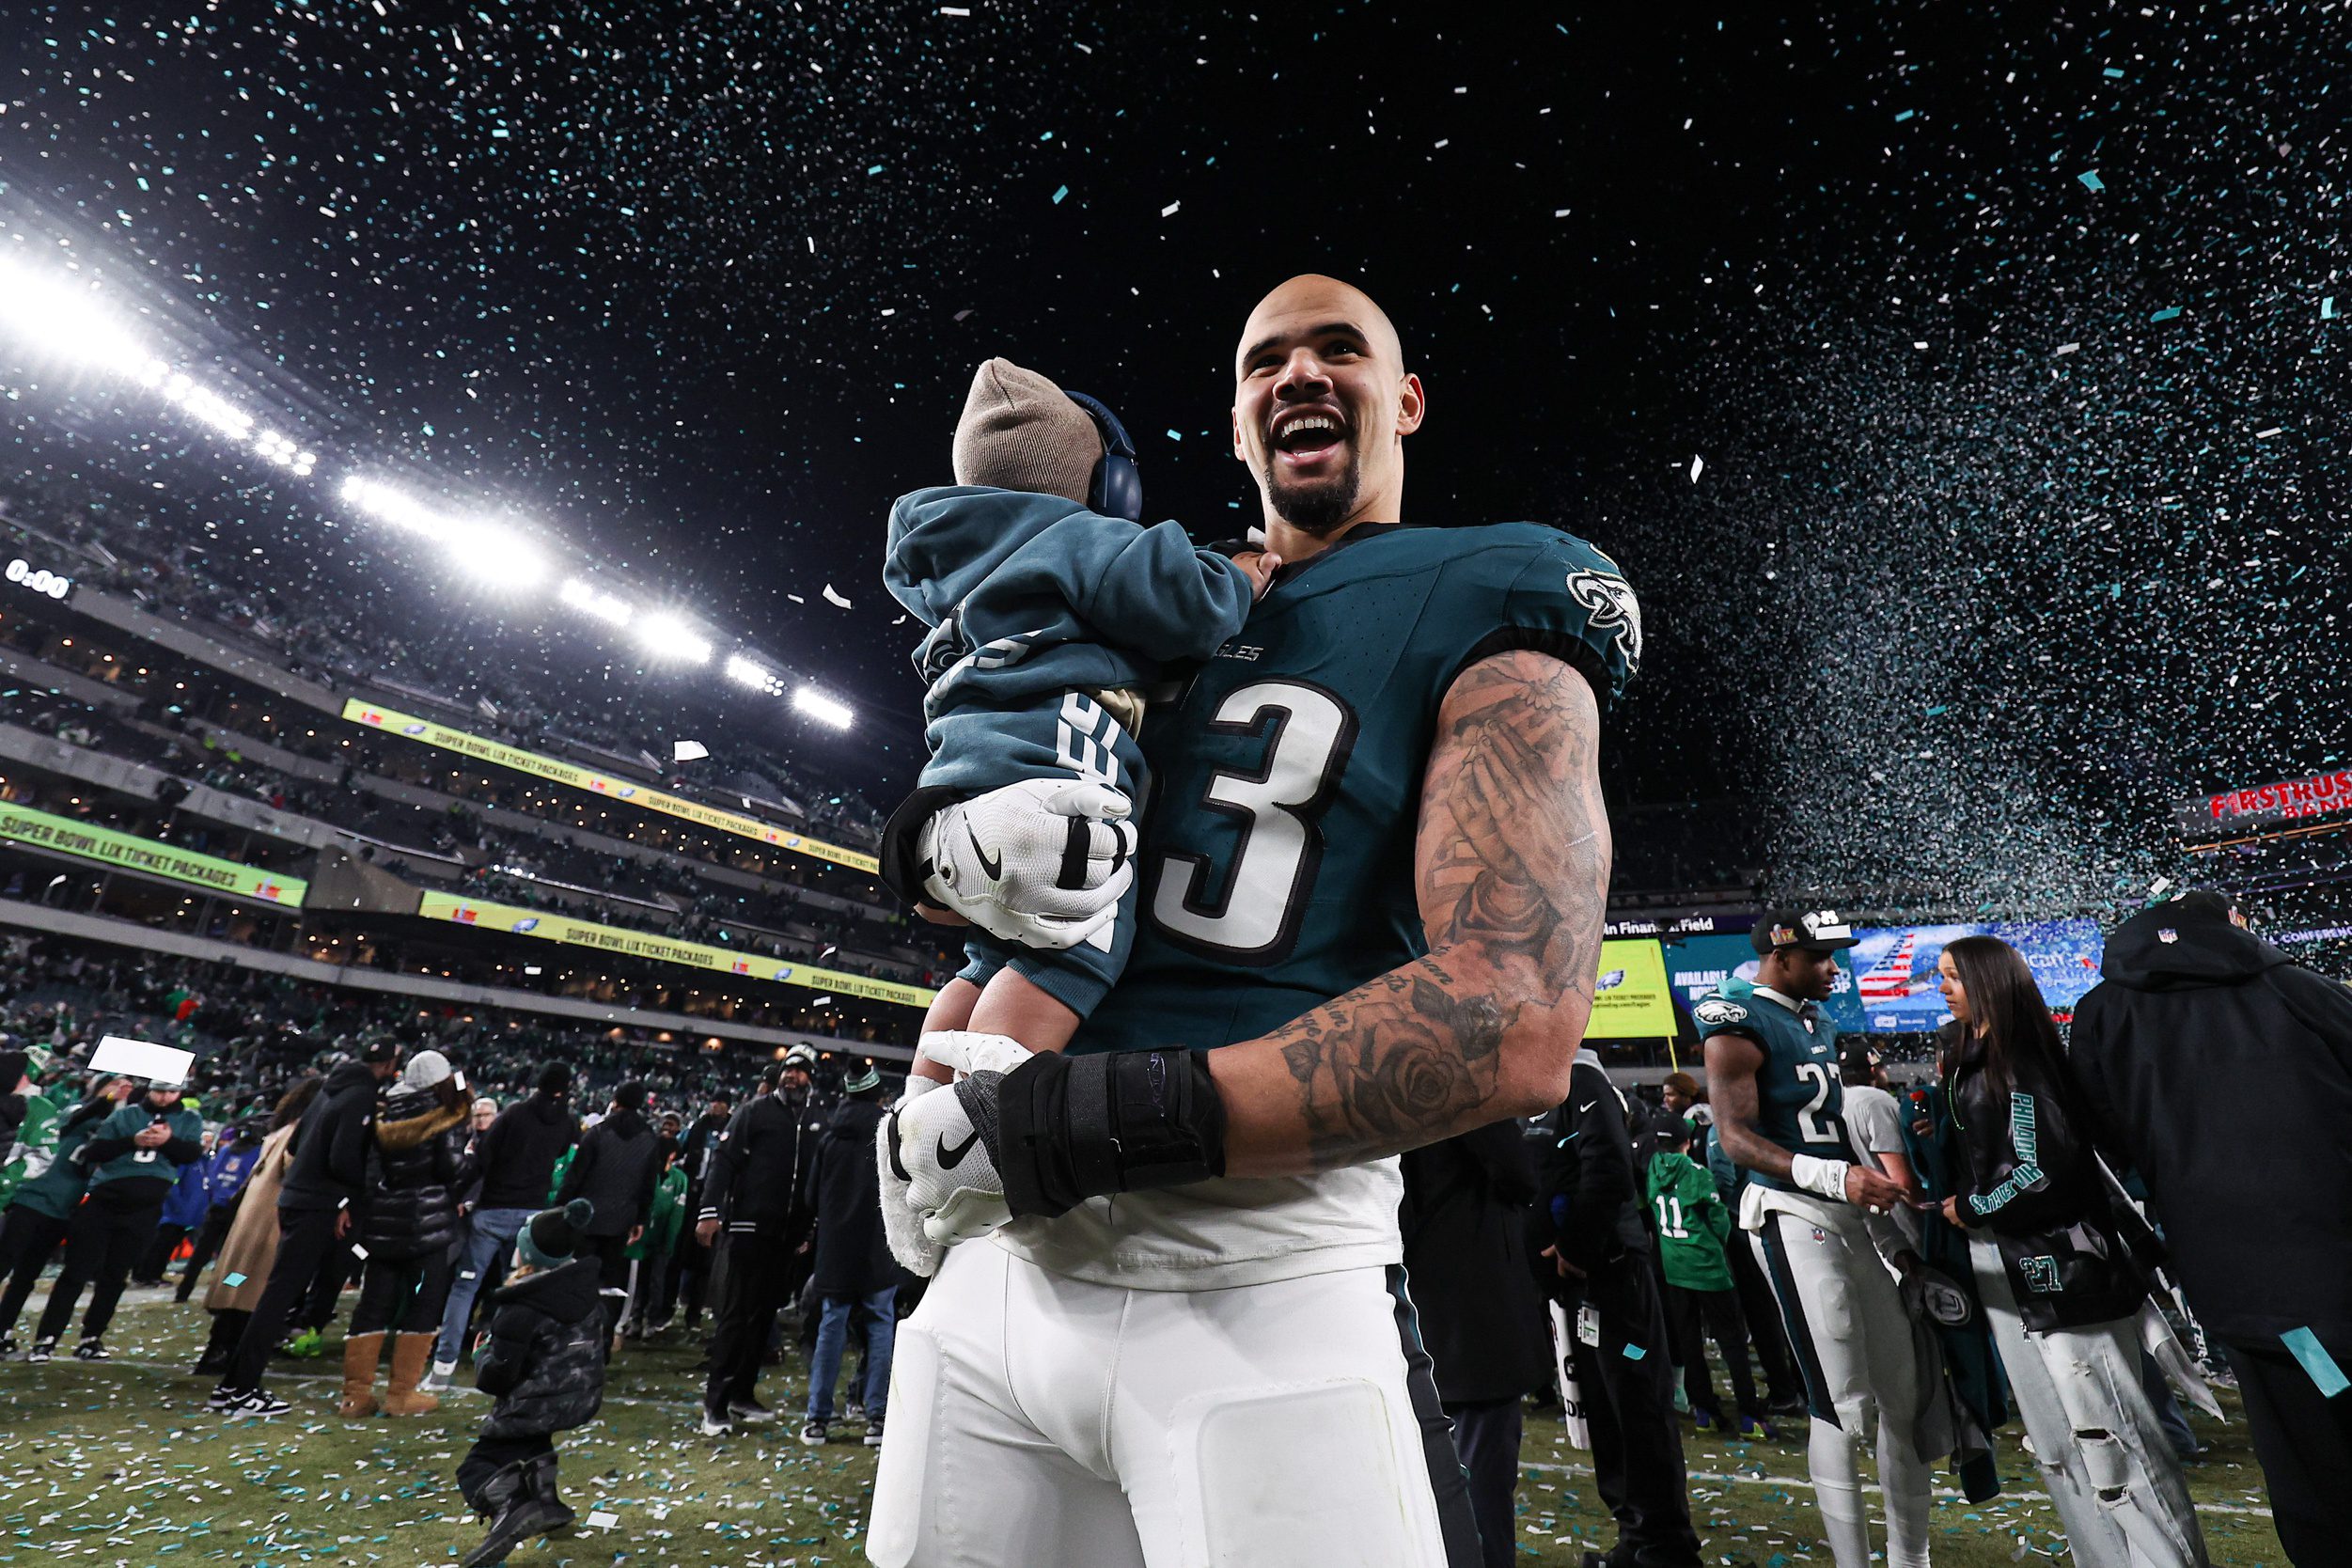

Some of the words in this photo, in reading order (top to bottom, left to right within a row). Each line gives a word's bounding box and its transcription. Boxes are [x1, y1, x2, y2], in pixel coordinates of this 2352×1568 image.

[5, 558, 70, 599] 0:00
[1, 816, 54, 841] SUPER
[54, 829, 98, 854] BOWL
[124, 845, 170, 870] TICKET
[170, 859, 238, 887] PACKAGES
[1679, 917, 1715, 933] Field
[565, 928, 597, 944] SUPER
[597, 933, 624, 950] BOWL
[641, 941, 670, 958] TICKET
[671, 948, 714, 966] PACKAGES
[1674, 970, 1728, 987] AVAILABLE
[1968, 1179, 2018, 1215] EAGLES
[1655, 1194, 1690, 1239] 11
[2019, 1255, 2063, 1294] 27
